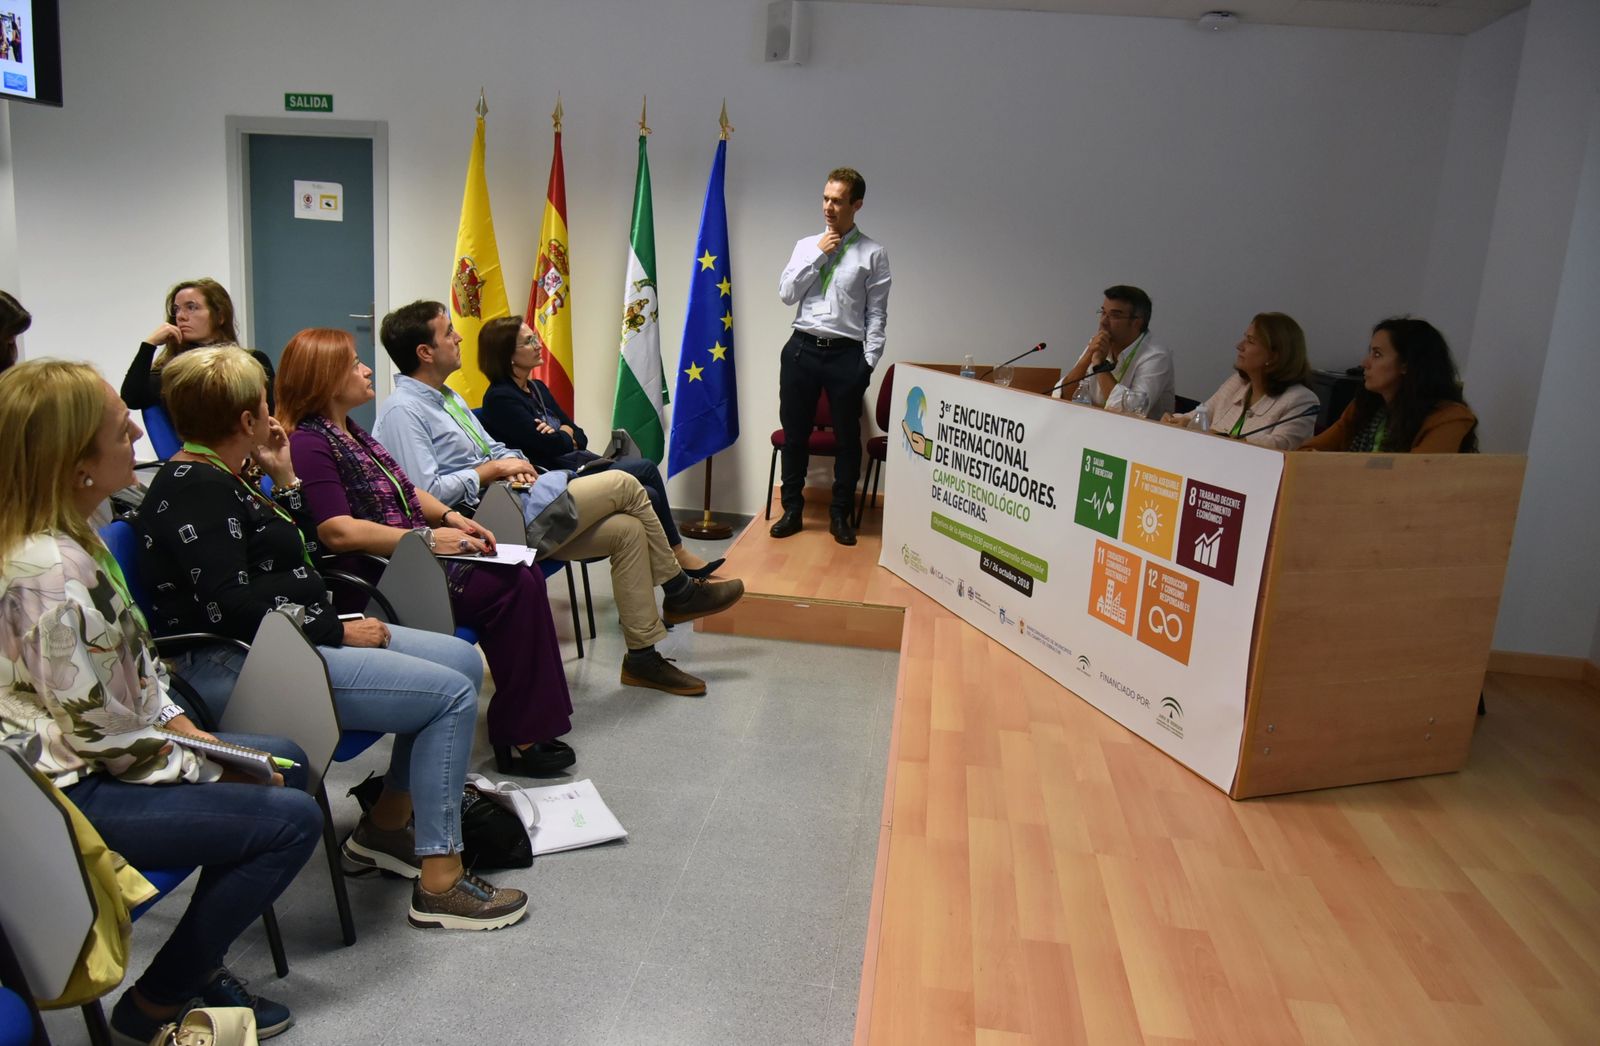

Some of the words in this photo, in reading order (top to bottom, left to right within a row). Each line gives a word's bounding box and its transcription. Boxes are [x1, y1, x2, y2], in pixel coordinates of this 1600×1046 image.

[289, 95, 328, 108] SALIDA
[953, 404, 1025, 444] ENCUENTRO
[937, 422, 1029, 472] INTERNACIONAL
[1085, 455, 1091, 472] 3
[935, 444, 950, 466] DE
[951, 450, 1057, 510] INVESTIGADORES.
[1134, 470, 1141, 488] 7
[931, 484, 942, 501] DE
[942, 490, 988, 523] ALGECIRAS.
[932, 468, 966, 494] CAMPUS
[967, 481, 1031, 523] TECNOLÓGICO
[1188, 486, 1197, 506] 8
[1199, 488, 1221, 504] TRABAJO
[1220, 495, 1241, 510] DECENTE
[1201, 500, 1232, 518] CRECIMIENTO
[1097, 546, 1105, 565] 11
[982, 556, 990, 568] 25
[992, 562, 999, 573] 26
[998, 566, 1017, 584] octubre
[1017, 575, 1030, 591] 2018
[1148, 568, 1159, 589] 12
[1099, 671, 1136, 700] FINANCIADO
